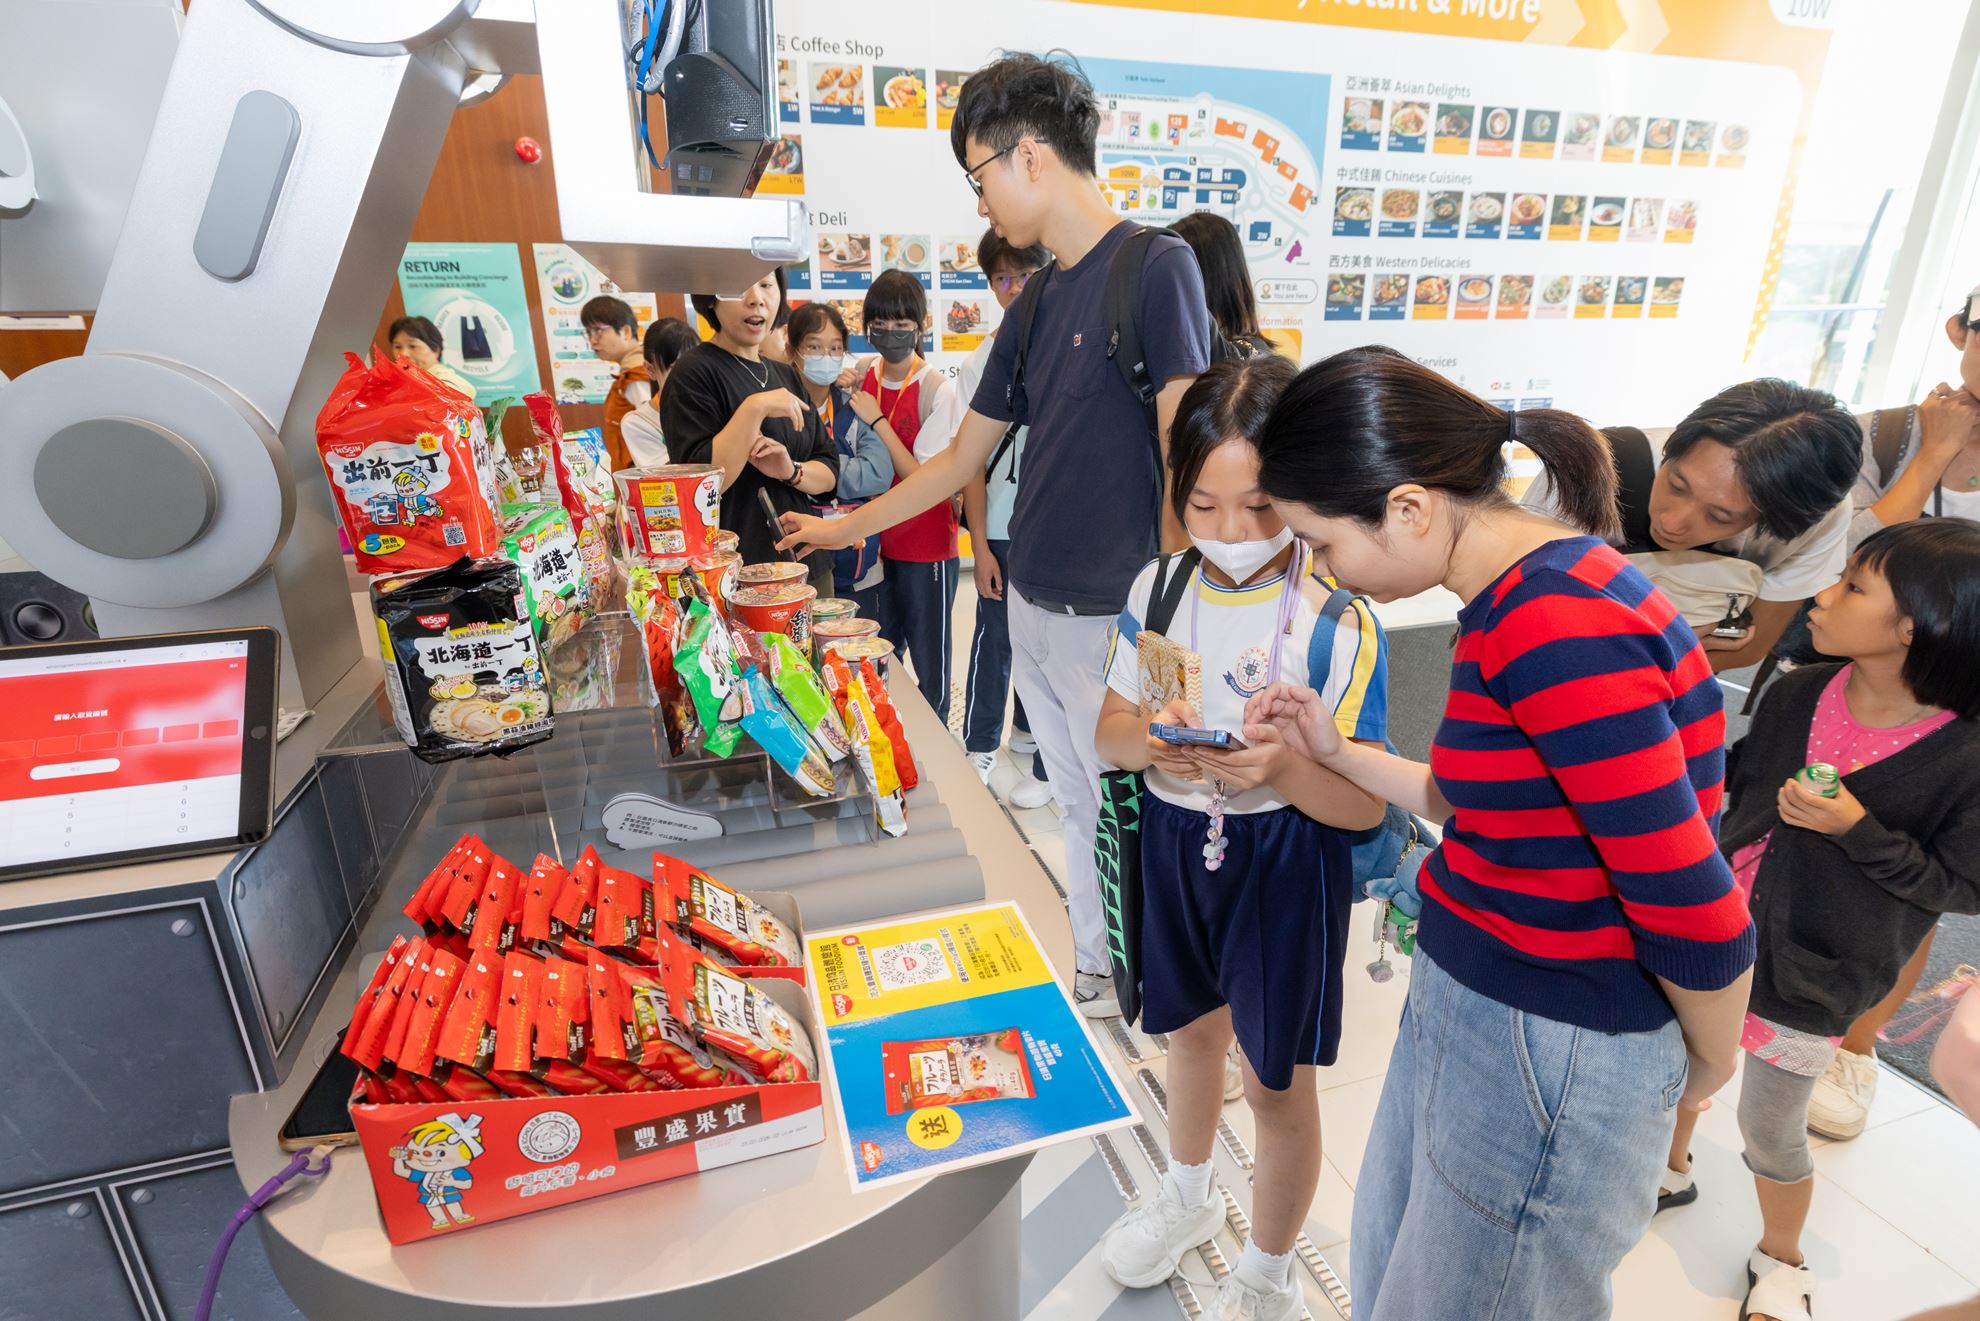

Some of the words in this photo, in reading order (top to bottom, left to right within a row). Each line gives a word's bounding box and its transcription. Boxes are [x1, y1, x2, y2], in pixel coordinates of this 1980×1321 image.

[791, 36, 840, 54] Coffee
[845, 40, 884, 60] Shop
[1394, 80, 1425, 95] Asian
[1427, 82, 1472, 100] Delights
[1384, 169, 1427, 183] Chinese
[1429, 171, 1472, 185] Cuisines
[820, 212, 848, 226] Deli
[404, 261, 460, 273] RETURN
[1329, 254, 1373, 269] 西方美食
[1376, 256, 1418, 268] Western
[1420, 256, 1472, 269] Delicacies
[1417, 356, 1457, 367] Services
[335, 445, 362, 454] NISSIN
[343, 452, 441, 484] 出前一丁
[365, 533, 382, 552] 5
[420, 615, 448, 625] NISSIN
[427, 635, 532, 665] 北海道一丁
[472, 659, 504, 670] 出前一丁
[835, 994, 848, 1016] NISSIN
[634, 1103, 747, 1151] 豐盛果實
[919, 1114, 950, 1140] 送
